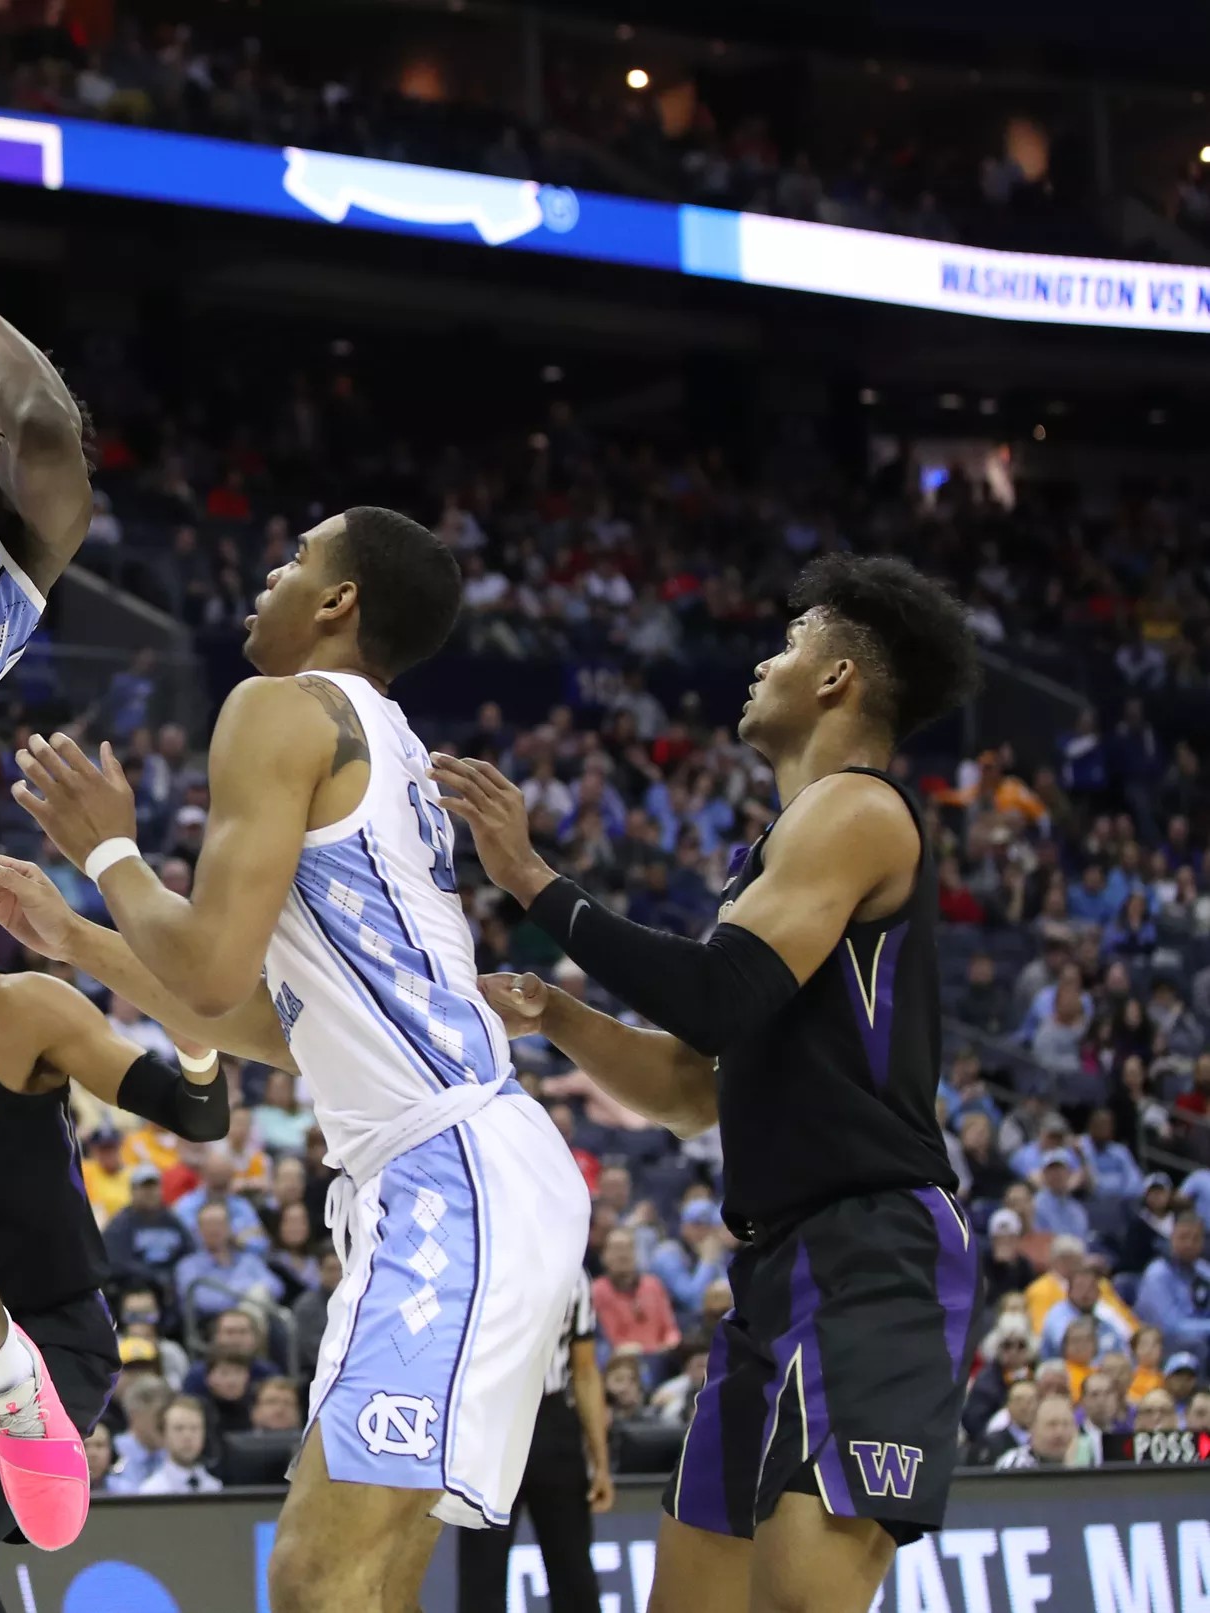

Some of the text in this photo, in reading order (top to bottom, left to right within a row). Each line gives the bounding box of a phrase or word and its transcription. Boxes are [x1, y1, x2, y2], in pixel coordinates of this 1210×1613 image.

[941, 264, 1136, 310] WASHINGTON
[1149, 280, 1186, 314] VS
[848, 1440, 923, 1499] W
